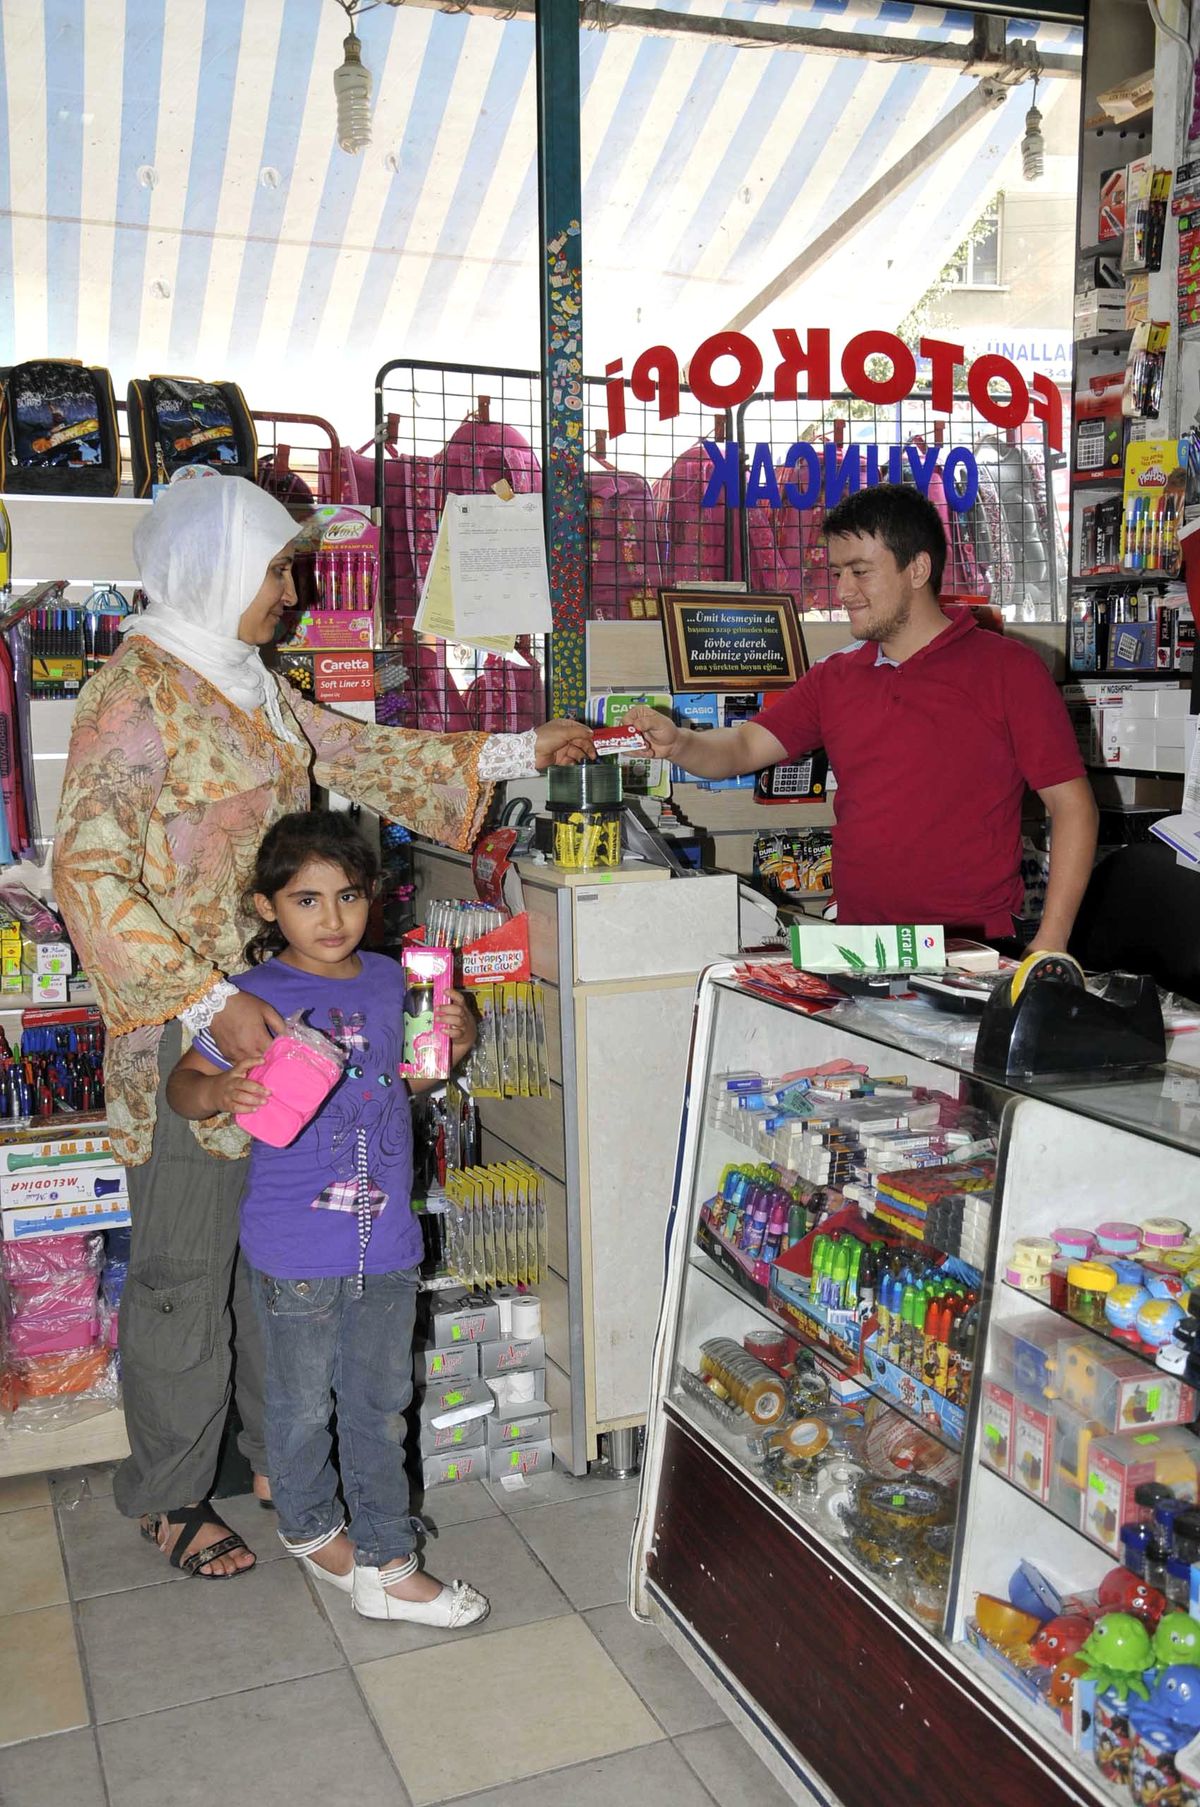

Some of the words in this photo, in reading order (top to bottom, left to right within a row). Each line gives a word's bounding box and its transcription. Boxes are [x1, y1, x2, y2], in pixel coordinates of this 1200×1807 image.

[721, 613, 762, 625] kesmeyin
[765, 614, 775, 623] de
[704, 637, 731, 648] tövbe
[733, 637, 767, 648] ederek
[691, 650, 741, 661] Rabbinize
[743, 650, 784, 662] yönelin,
[320, 659, 369, 673] Caretta
[320, 680, 337, 690] Soft
[339, 680, 359, 688] Liner
[684, 707, 714, 715] CASIO
[901, 928, 912, 953] esrar
[494, 963, 513, 971] GLUE
[11, 1177, 79, 1192] MELODİKA
